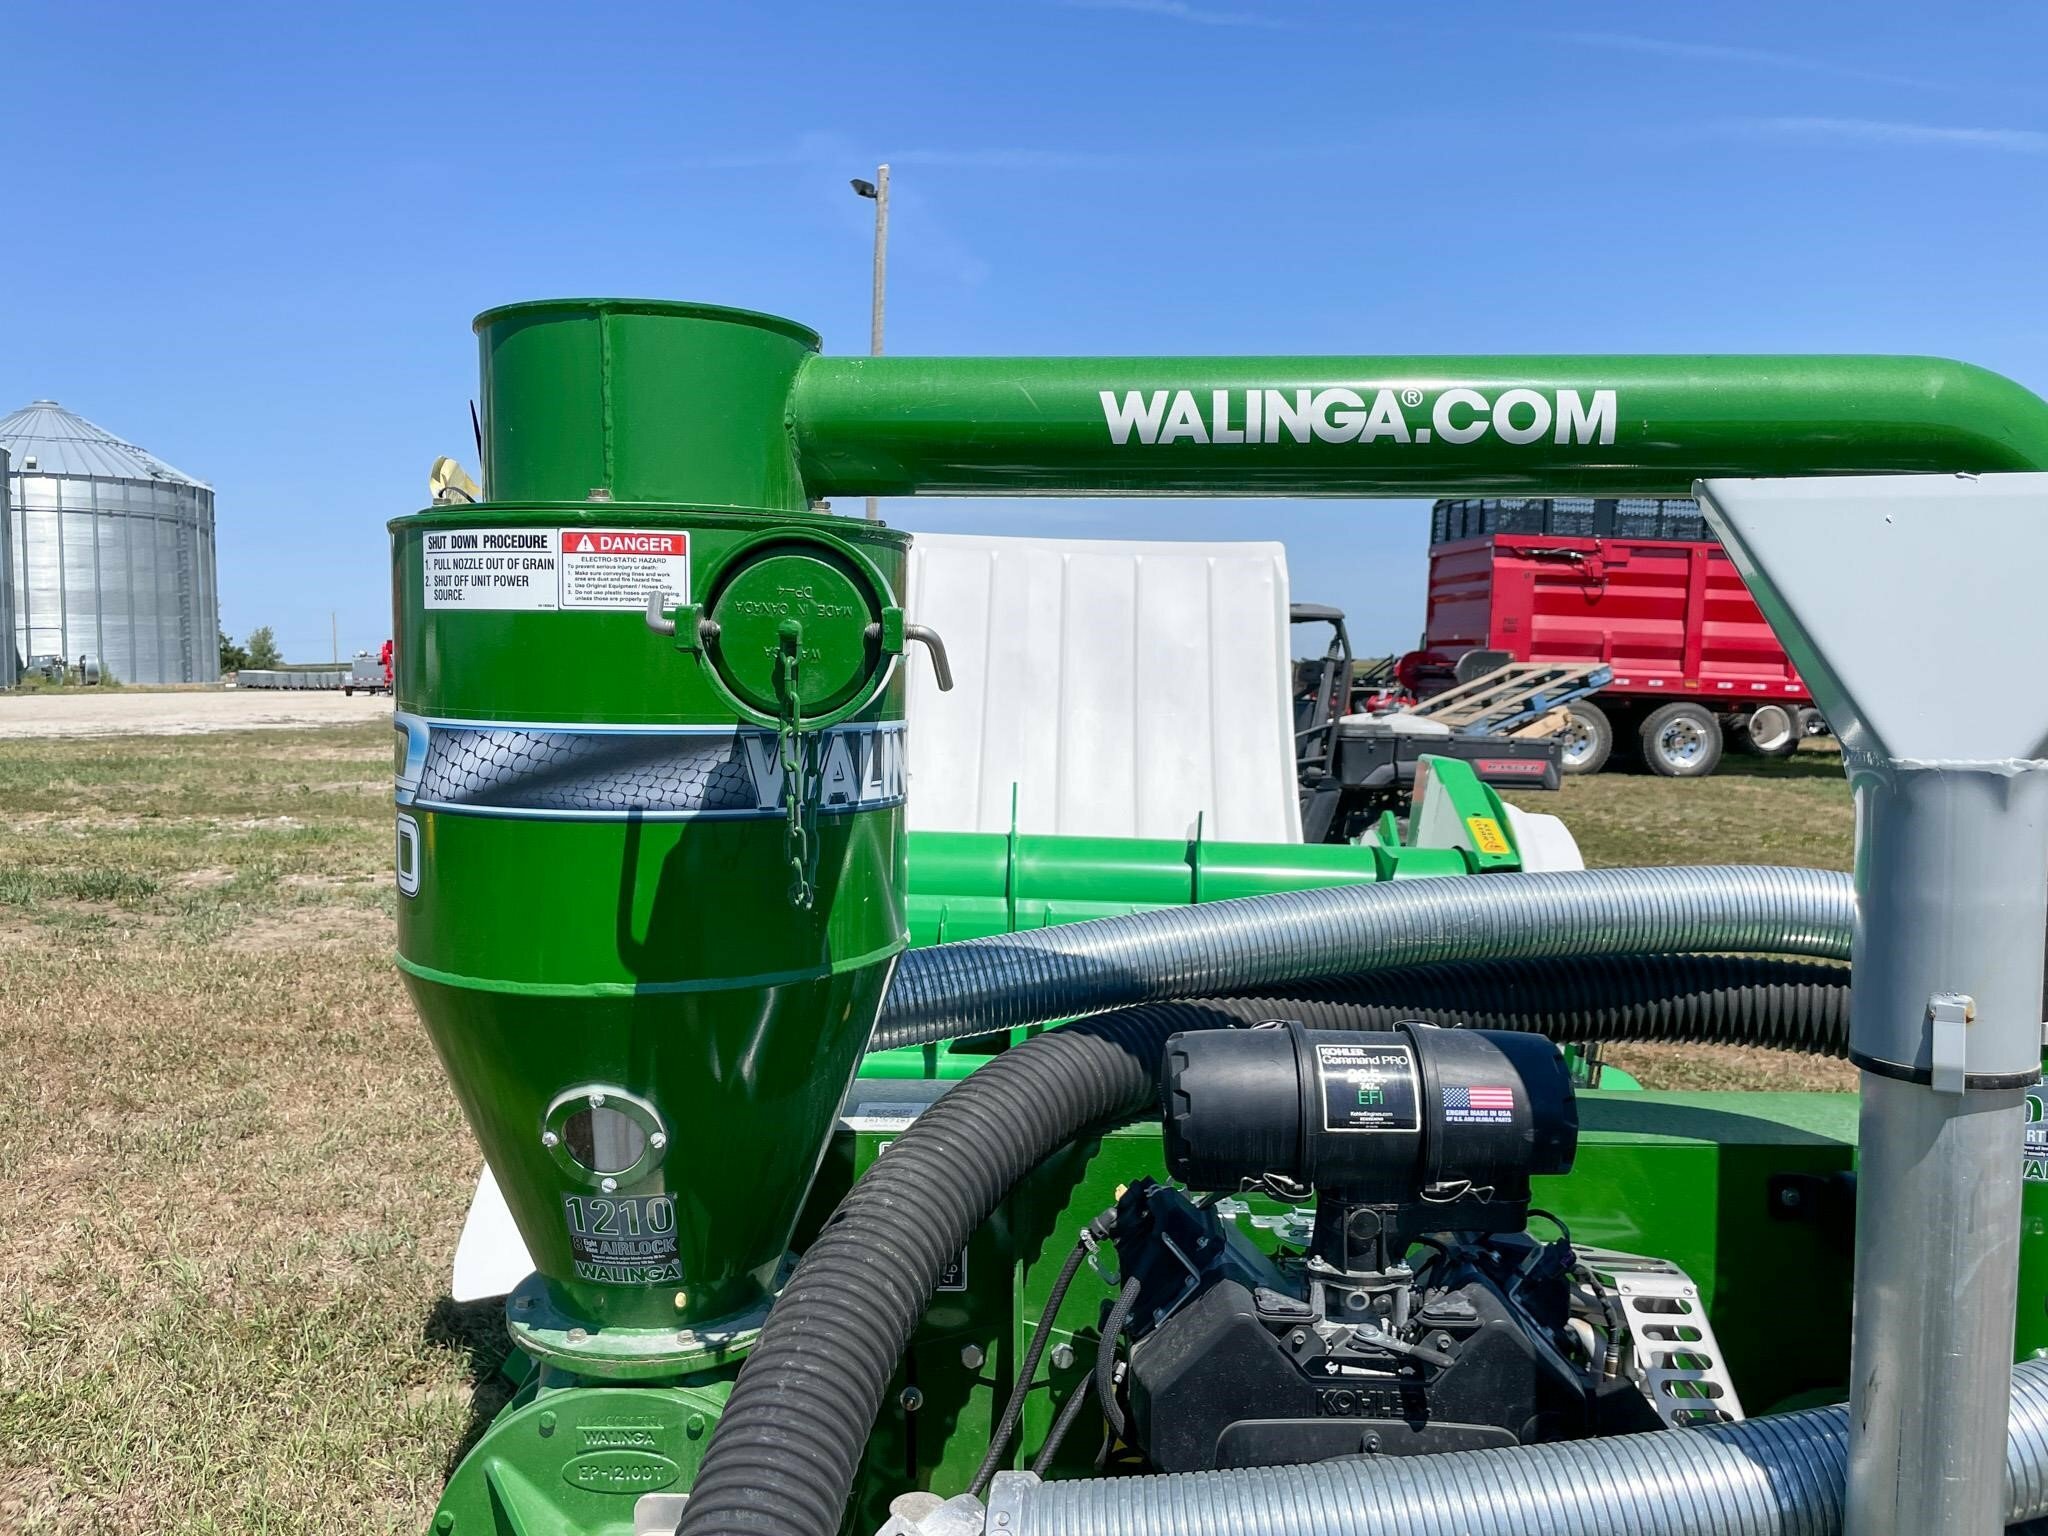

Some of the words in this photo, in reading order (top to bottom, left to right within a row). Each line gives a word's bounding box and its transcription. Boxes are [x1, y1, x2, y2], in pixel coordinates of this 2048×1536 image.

[428, 536, 447, 550] SHUT
[451, 535, 478, 549] DOWN
[483, 534, 548, 548] PROCEDURE
[600, 536, 672, 552] DANGER
[425, 560, 430, 570] 1.
[434, 559, 451, 570] PULL
[453, 558, 483, 570] NOZZLE
[486, 558, 504, 570] OUT
[507, 558, 520, 570] OF
[522, 558, 554, 570] GRAIN
[425, 576, 431, 587] 2.
[434, 575, 452, 586] SHUT
[454, 575, 469, 586] OFF
[472, 575, 491, 586] UNIT
[494, 575, 529, 586] POWER
[434, 589, 465, 600] SOURCE.
[735, 601, 788, 616] CANADA
[799, 604, 808, 616] IN
[817, 604, 852, 618] MADE
[1322, 1056, 1379, 1065] Command
[1381, 1056, 1408, 1065] PRO
[1358, 1090, 1384, 1104] EFI
[566, 1196, 674, 1236] 1210
[600, 1238, 677, 1256] AIRLOCK
[1316, 1389, 1434, 1416] KOHLE
[583, 1430, 656, 1445] WALINGA
